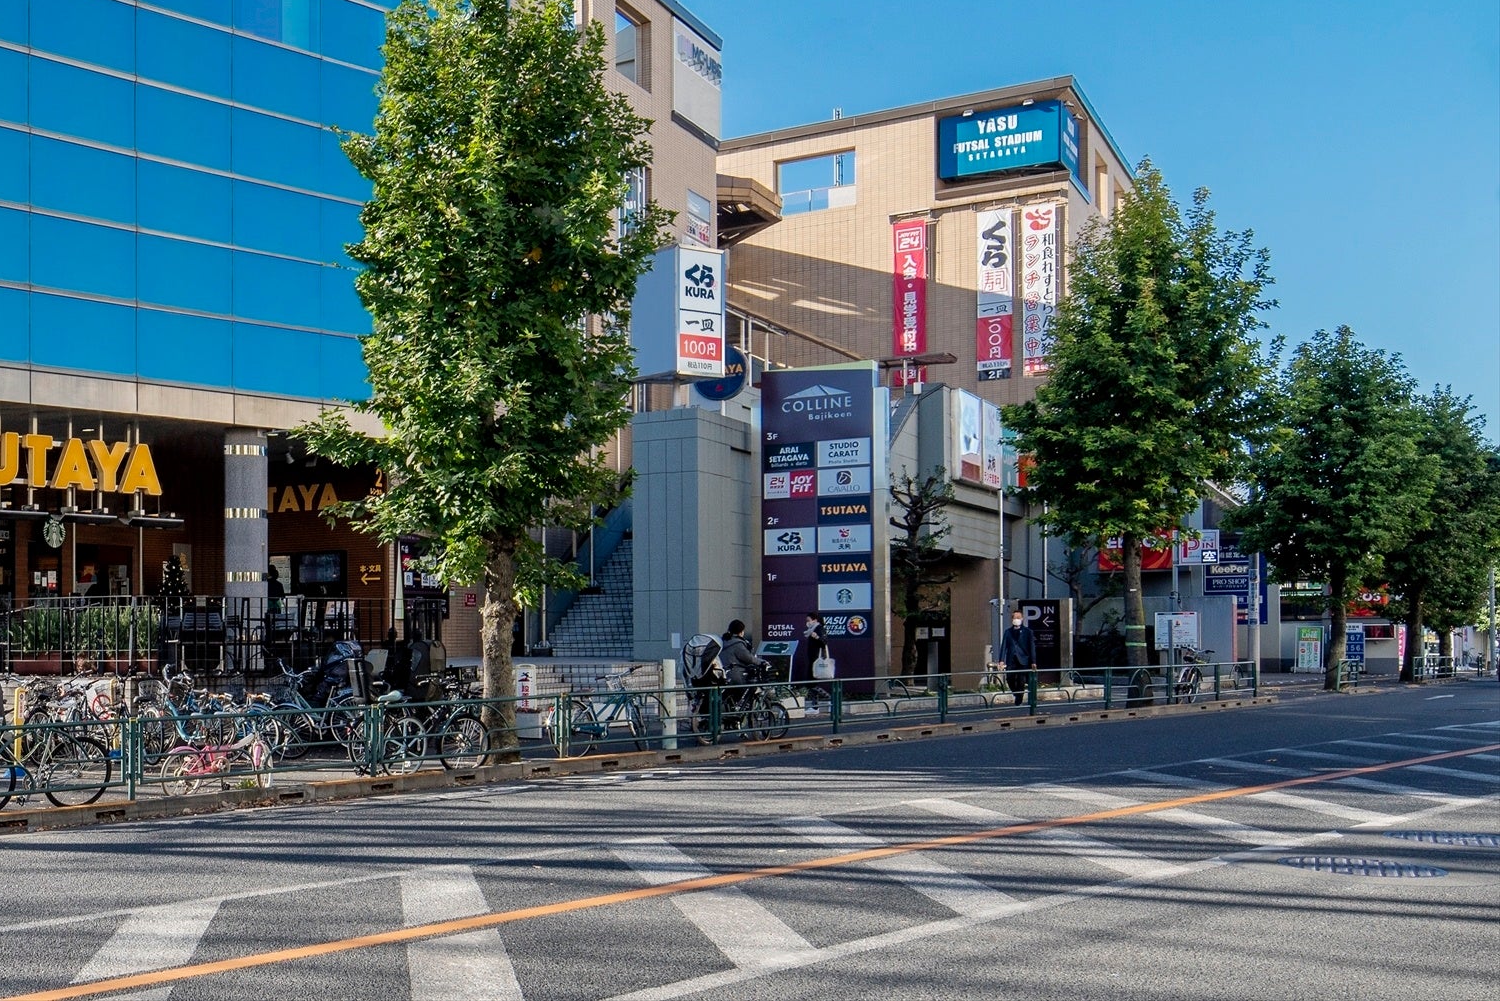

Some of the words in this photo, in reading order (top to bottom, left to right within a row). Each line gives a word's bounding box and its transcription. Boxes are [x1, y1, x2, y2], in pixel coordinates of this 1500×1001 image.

[977, 114, 1018, 135] YASU
[953, 138, 989, 154] FUTSAL
[994, 130, 1043, 148] STADIUM
[968, 146, 1026, 161] SETAGAYA
[899, 236, 920, 249] 24
[684, 263, 715, 288] くら
[684, 286, 715, 300] KURA
[683, 339, 717, 357] 100円
[687, 361, 713, 371] 税込110円
[988, 370, 1004, 380] 2F
[781, 396, 852, 413] COLLINE
[808, 412, 852, 421] Bajikoen
[766, 432, 778, 441] 3F
[779, 446, 799, 455] ARAI
[829, 441, 859, 450] STUDIO
[769, 454, 809, 463] SETAGAYA
[828, 450, 859, 458] CARATT
[769, 476, 785, 486] 24
[790, 474, 814, 485] JOY
[827, 485, 860, 493] CAVALLO
[267, 482, 338, 514] TAYA
[821, 504, 868, 515] TSUTAYA
[767, 516, 779, 525] 2F
[777, 531, 802, 545] くら
[777, 544, 802, 552] KURA
[1202, 541, 1215, 549] IN
[1202, 550, 1217, 562] 空
[821, 563, 868, 573] TSUTAYA
[1211, 565, 1248, 574] KeePer
[767, 573, 778, 581] 1F
[1228, 577, 1248, 585] SHOP
[822, 615, 848, 625] YASU
[1022, 605, 1042, 628] P
[1043, 606, 1055, 614] IN
